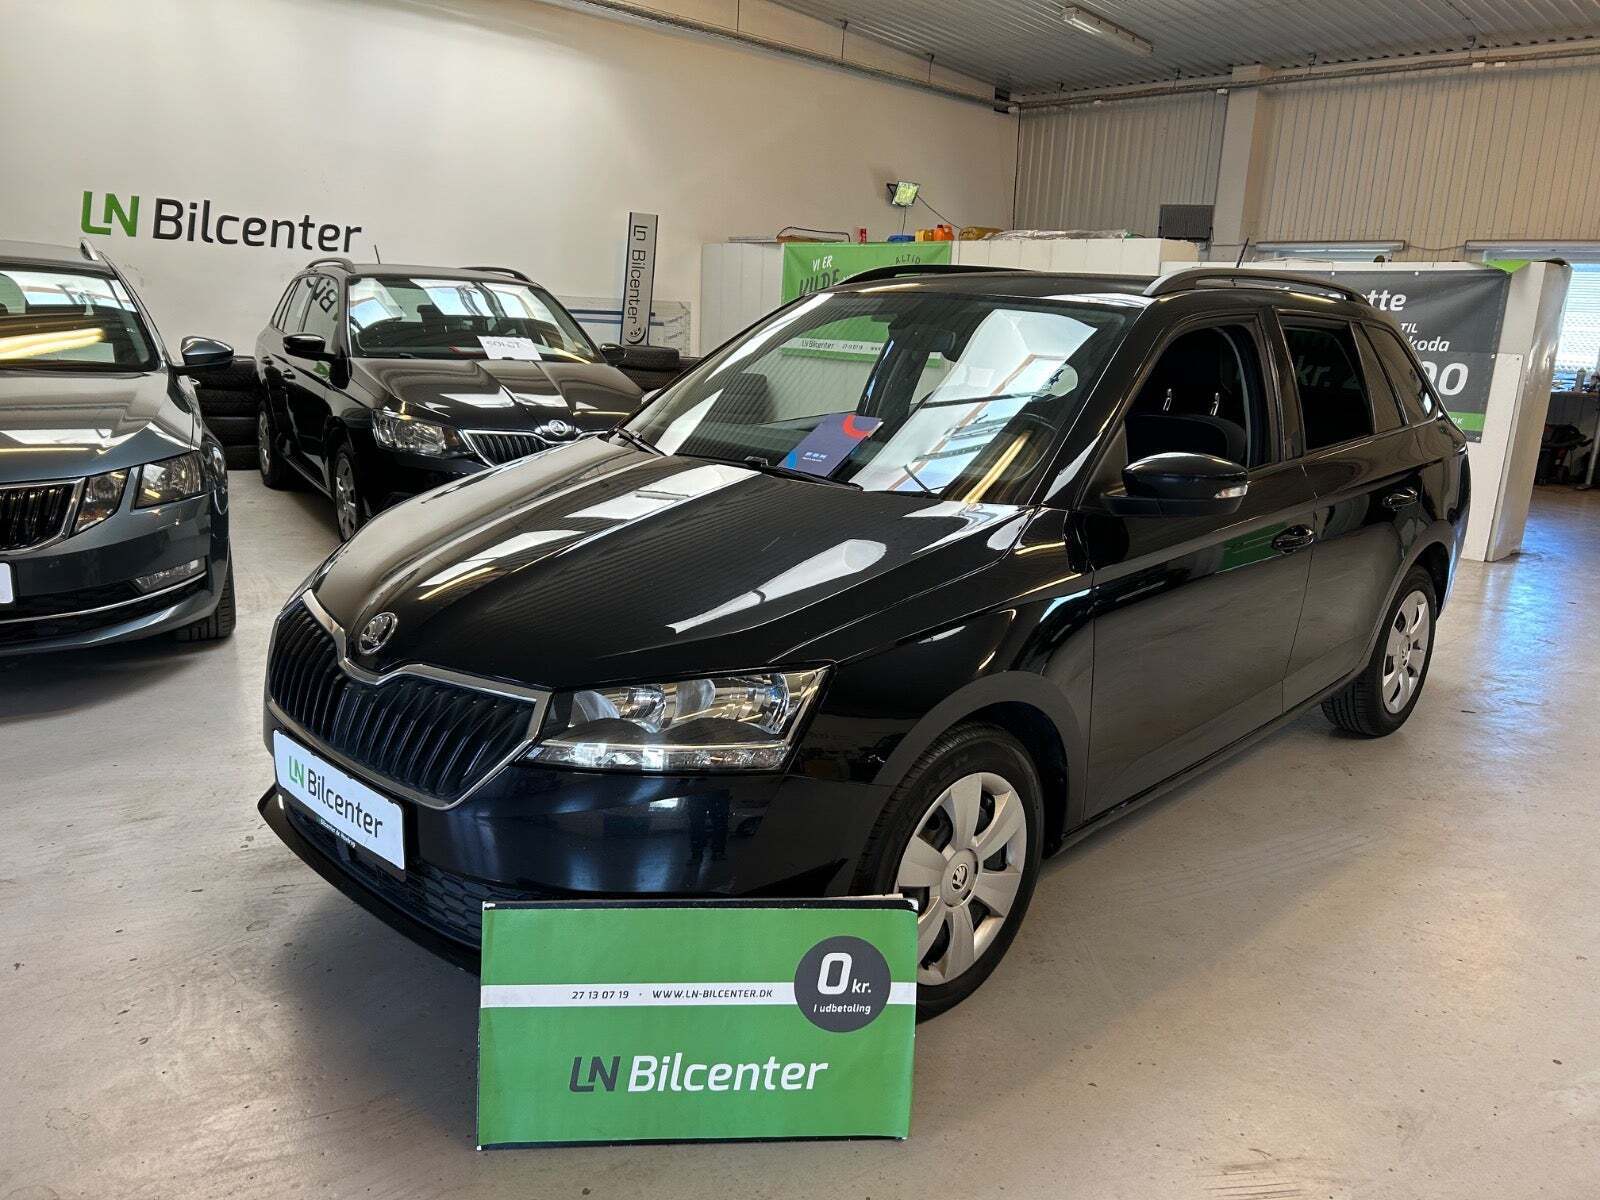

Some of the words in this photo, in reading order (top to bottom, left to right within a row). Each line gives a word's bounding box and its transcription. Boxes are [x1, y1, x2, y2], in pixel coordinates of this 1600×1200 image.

[80, 191, 140, 237] LN
[152, 198, 362, 253] Bilcenter
[822, 255, 833, 269] ER
[895, 253, 921, 265] ALTID
[627, 249, 646, 325] Bilcenter
[1361, 289, 1406, 312] tte
[1400, 322, 1418, 334] TIL
[289, 755, 304, 789] LN
[307, 768, 383, 839] Bilcenter
[817, 952, 852, 995] 0
[851, 978, 872, 993] kr.
[572, 991, 584, 999] 27
[588, 991, 598, 999] 13
[602, 990, 615, 999] 07
[618, 990, 629, 999] 19
[652, 989, 773, 999] WWW.LN-BILCENTER.DK
[820, 1003, 871, 1015] udbetaling
[569, 1055, 621, 1092] LN
[628, 1052, 829, 1092] Bilcenter
